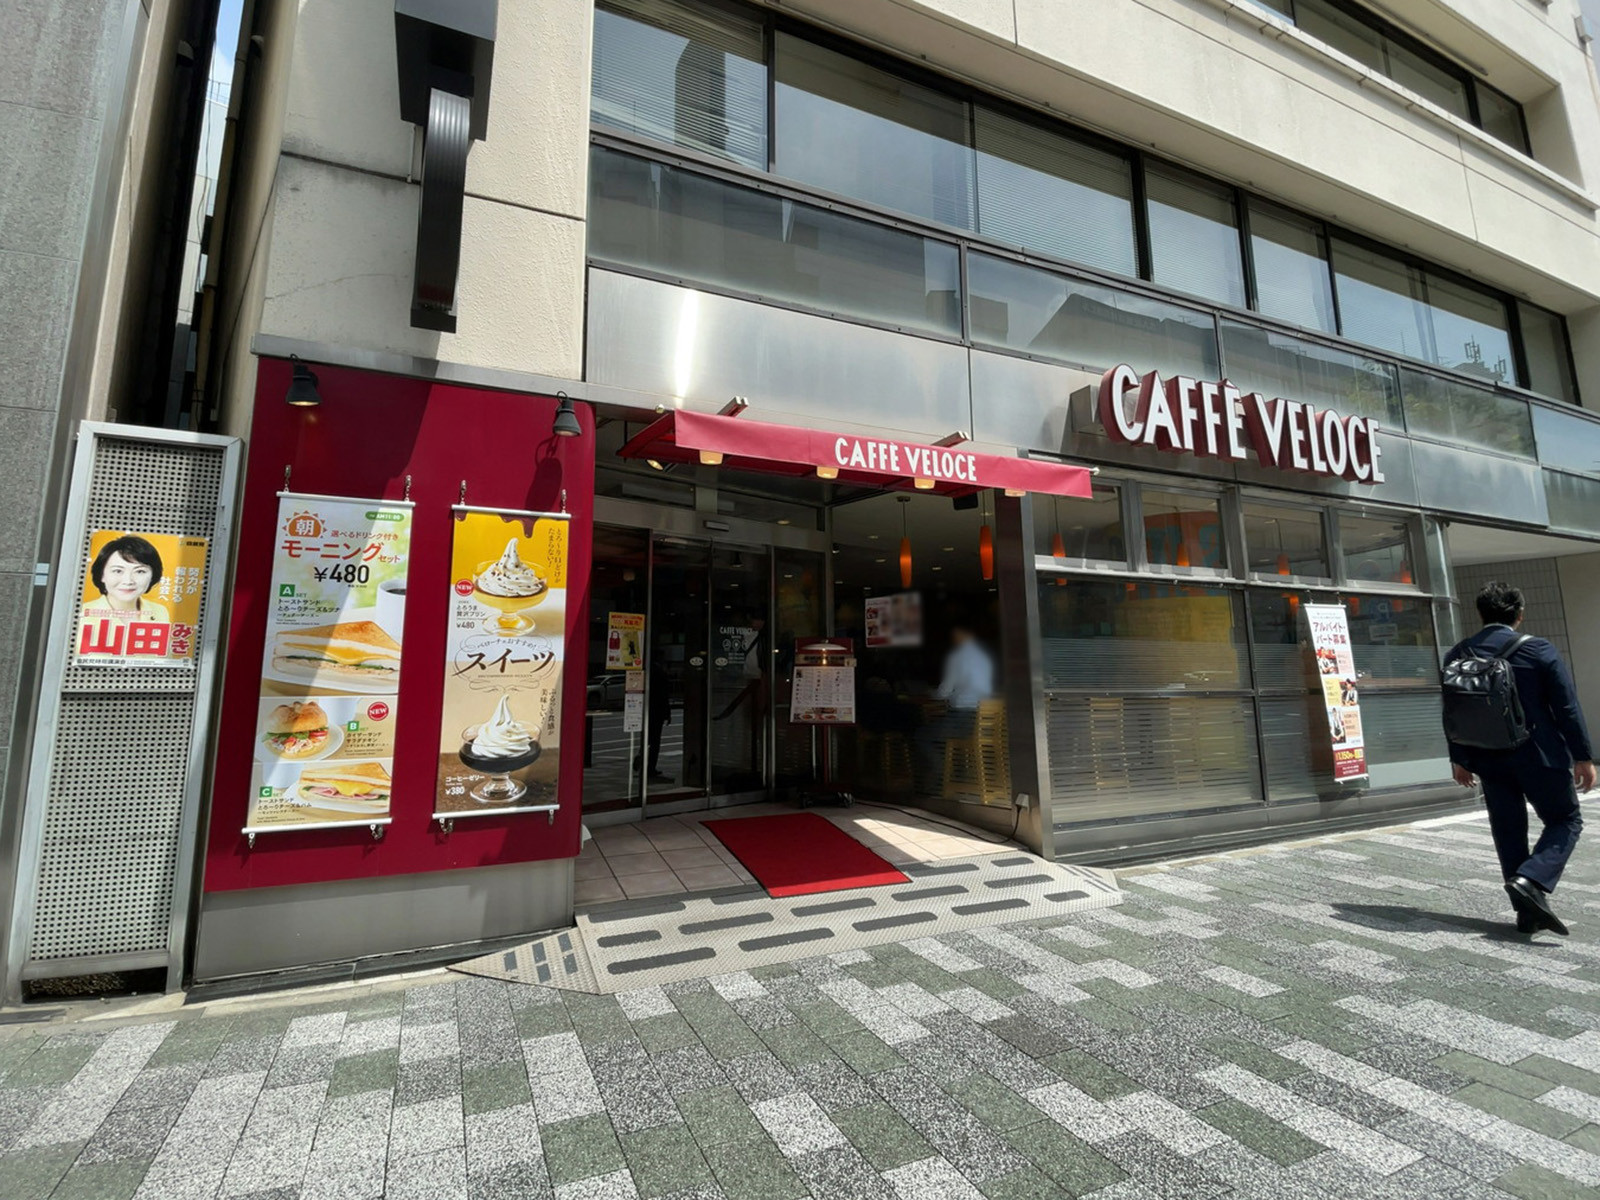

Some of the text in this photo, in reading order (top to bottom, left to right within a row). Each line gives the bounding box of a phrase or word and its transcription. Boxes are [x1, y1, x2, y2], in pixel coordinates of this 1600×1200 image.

[1106, 363, 1385, 483] CAFFÈ VELOCE
[834, 437, 978, 482] CAFFÈ VELOCE
[296, 519, 315, 537] 朝
[330, 530, 399, 541] 選べるドリンク付き
[314, 563, 370, 584] ¥480
[80, 619, 170, 656] 山田
[452, 648, 555, 677] スイーツ
